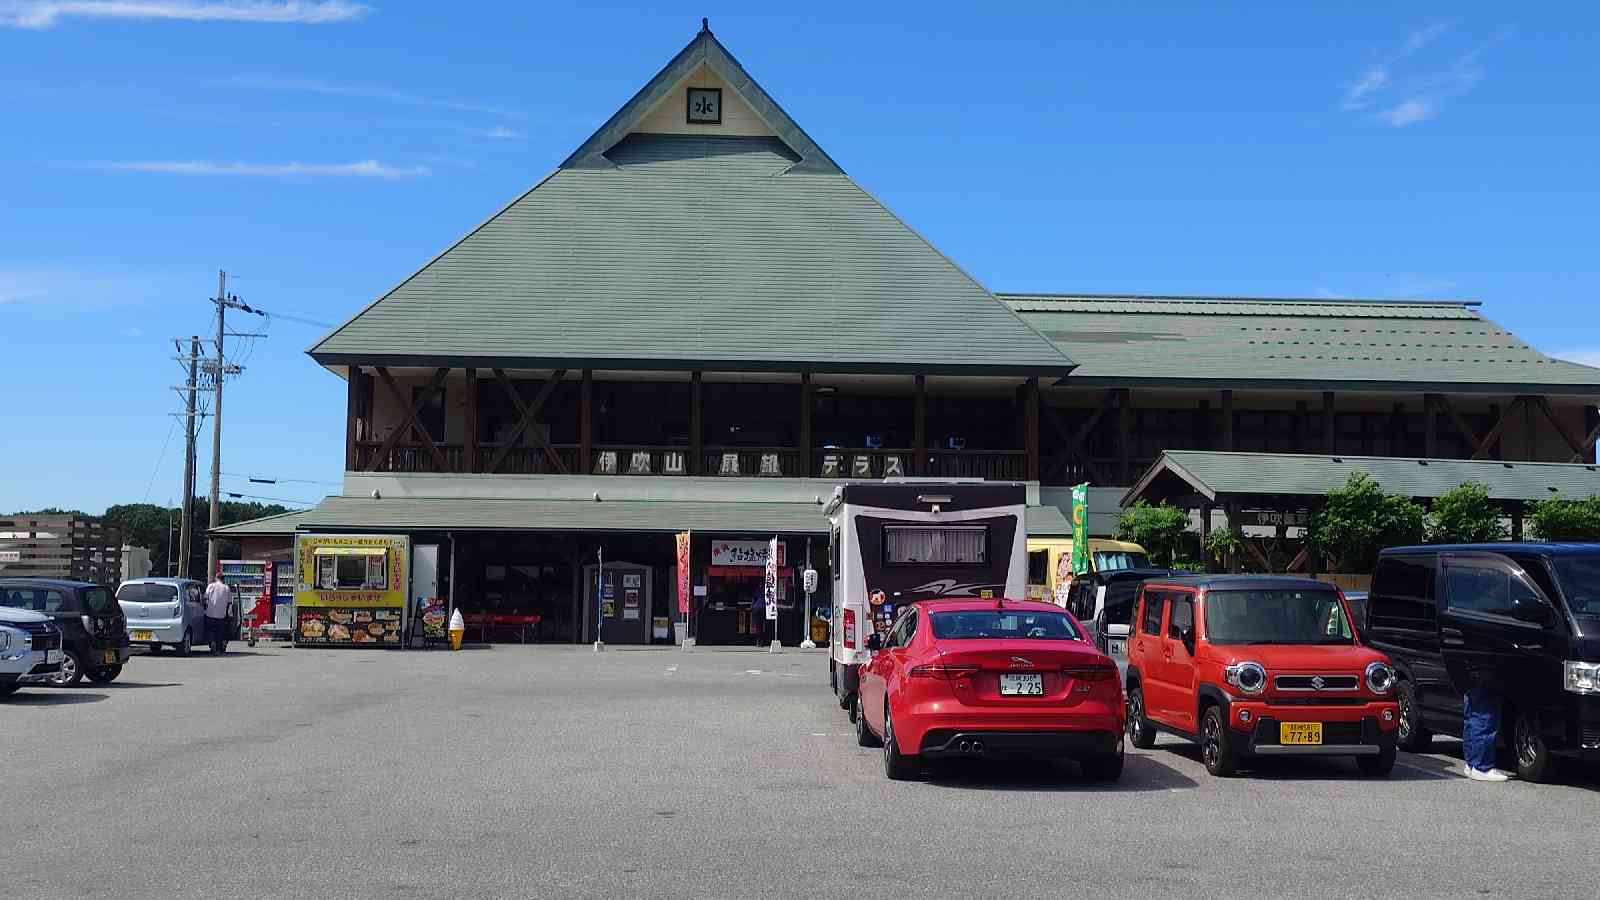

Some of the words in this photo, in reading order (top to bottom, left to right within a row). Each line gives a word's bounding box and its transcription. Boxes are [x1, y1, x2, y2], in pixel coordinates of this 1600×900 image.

[599, 451, 683, 472] 伊吹山
[823, 455, 901, 474] テラス
